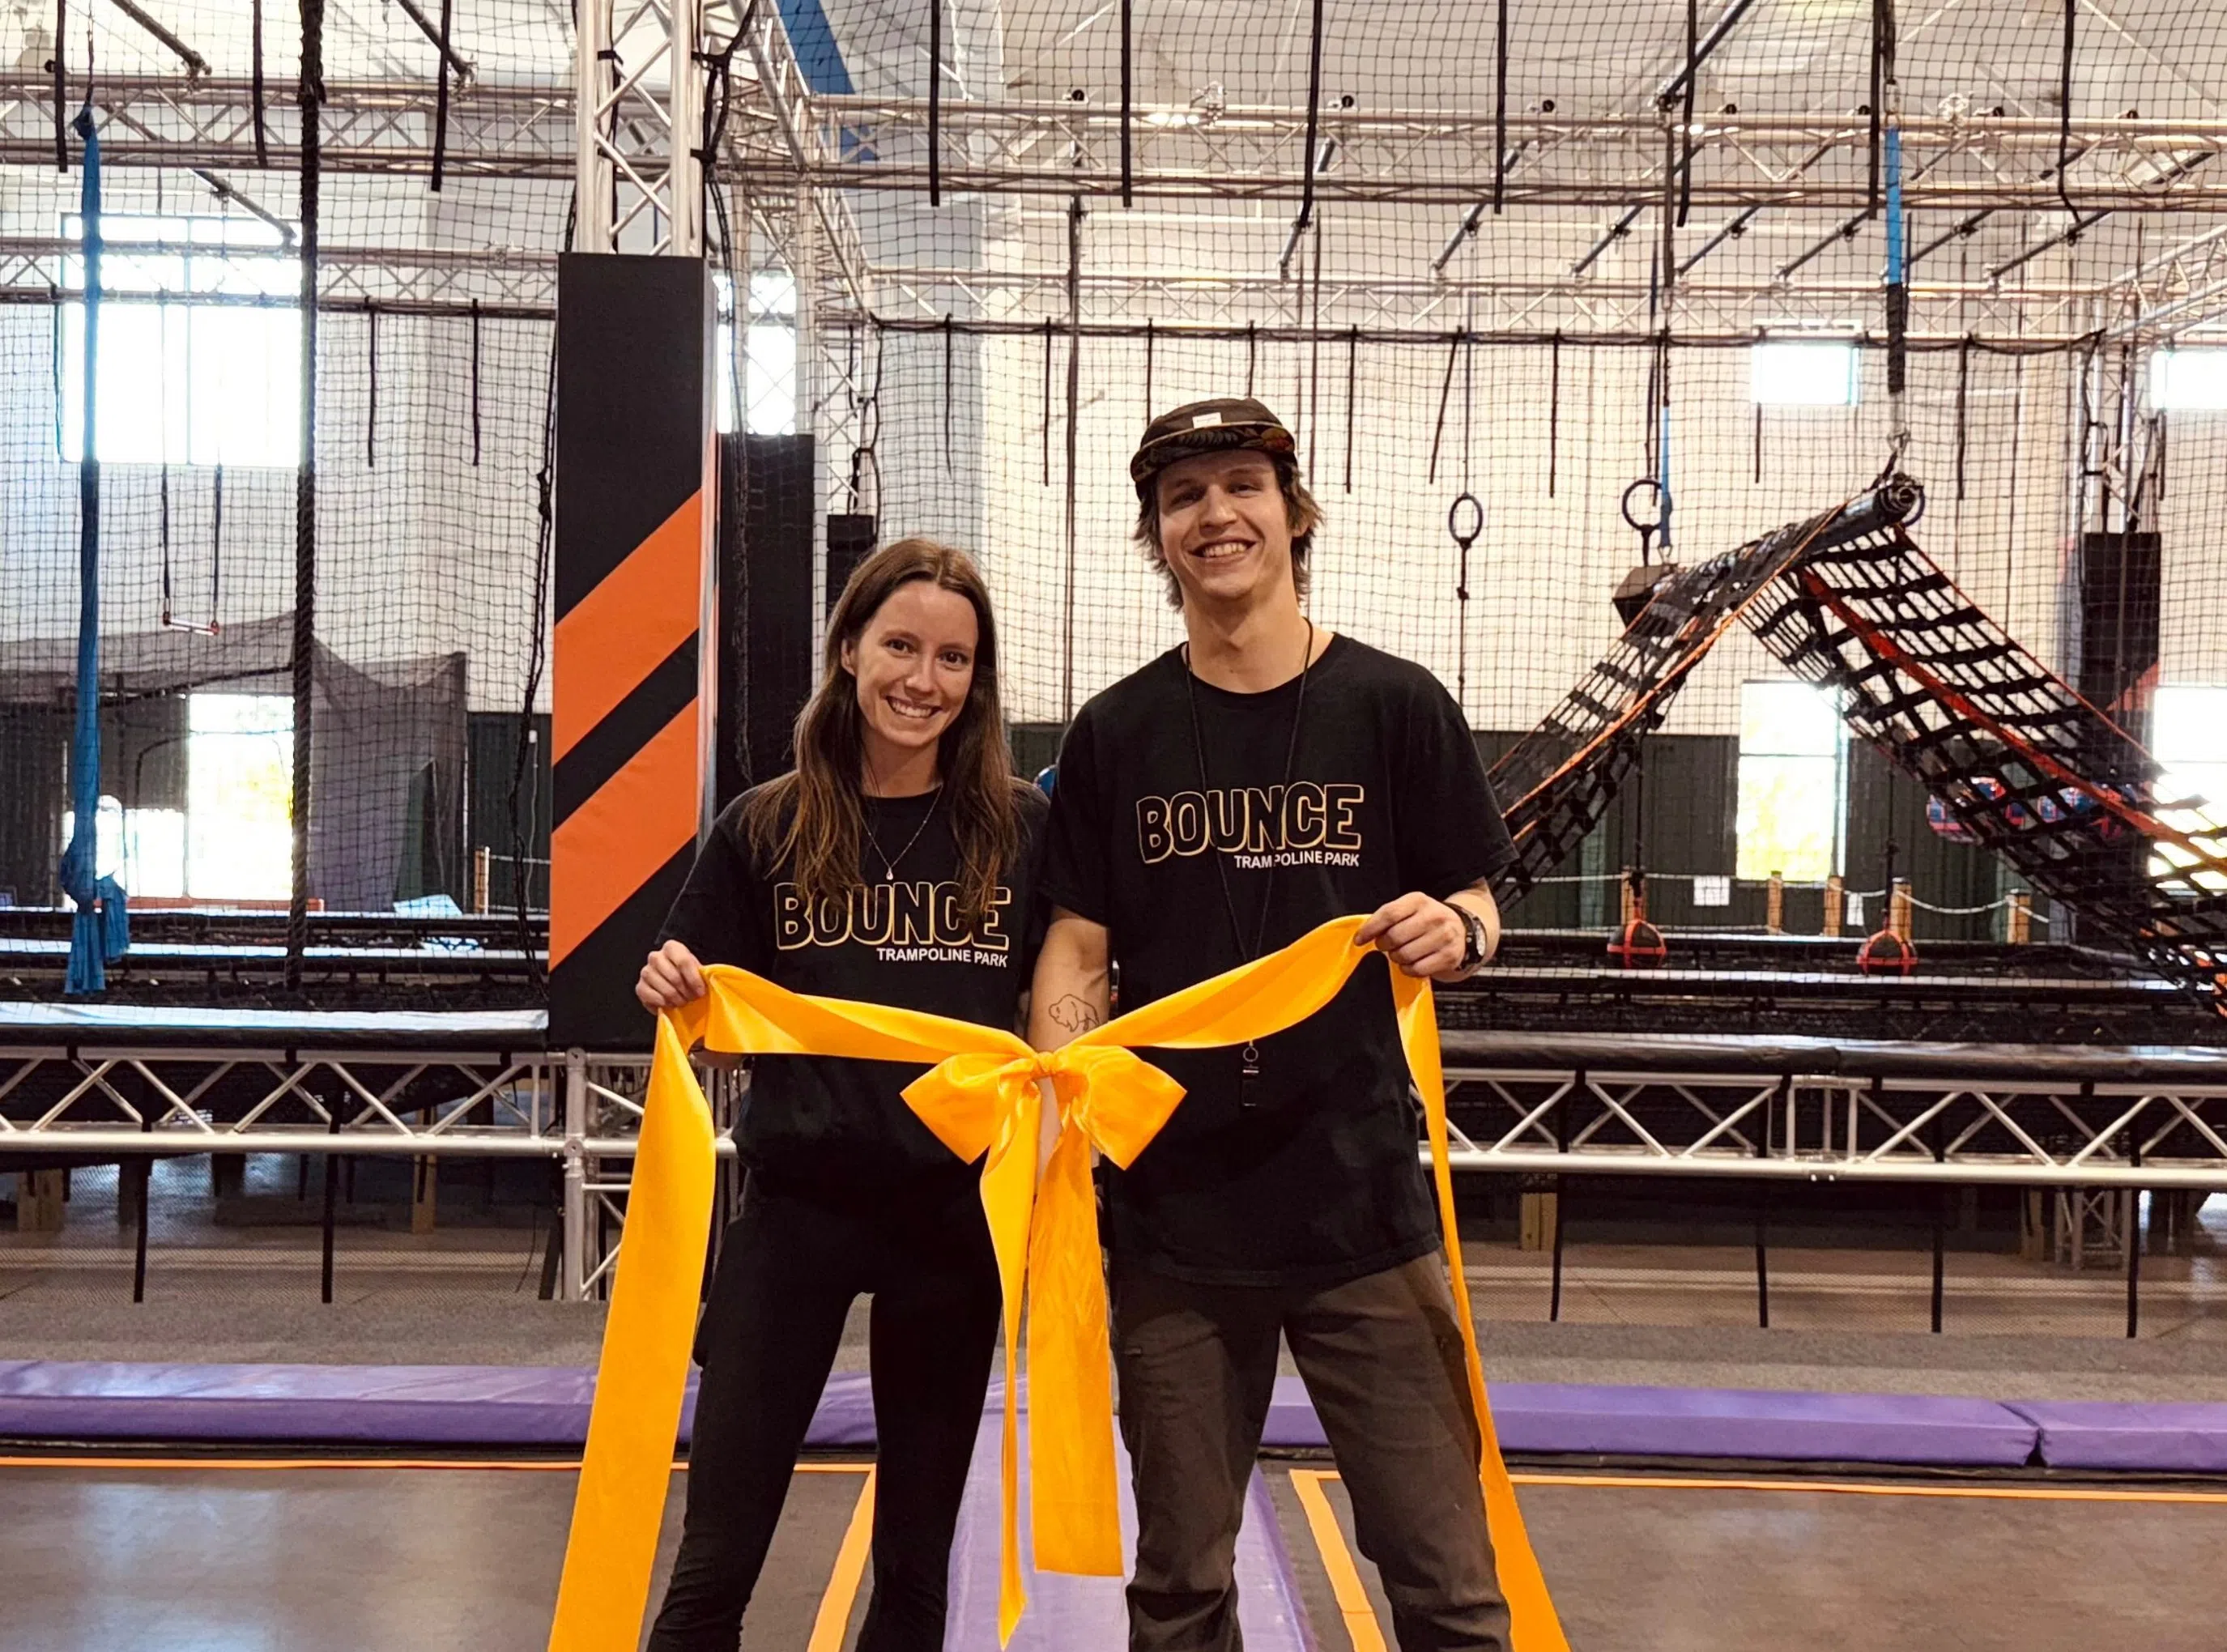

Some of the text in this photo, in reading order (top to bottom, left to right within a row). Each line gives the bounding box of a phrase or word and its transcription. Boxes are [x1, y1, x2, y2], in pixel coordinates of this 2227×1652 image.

[1136, 781, 1364, 864] BOUNCE
[1324, 852, 1360, 866] PARK
[774, 881, 1011, 951] BOUNCE
[876, 947, 1007, 967] TRAMPOLINE PARK
